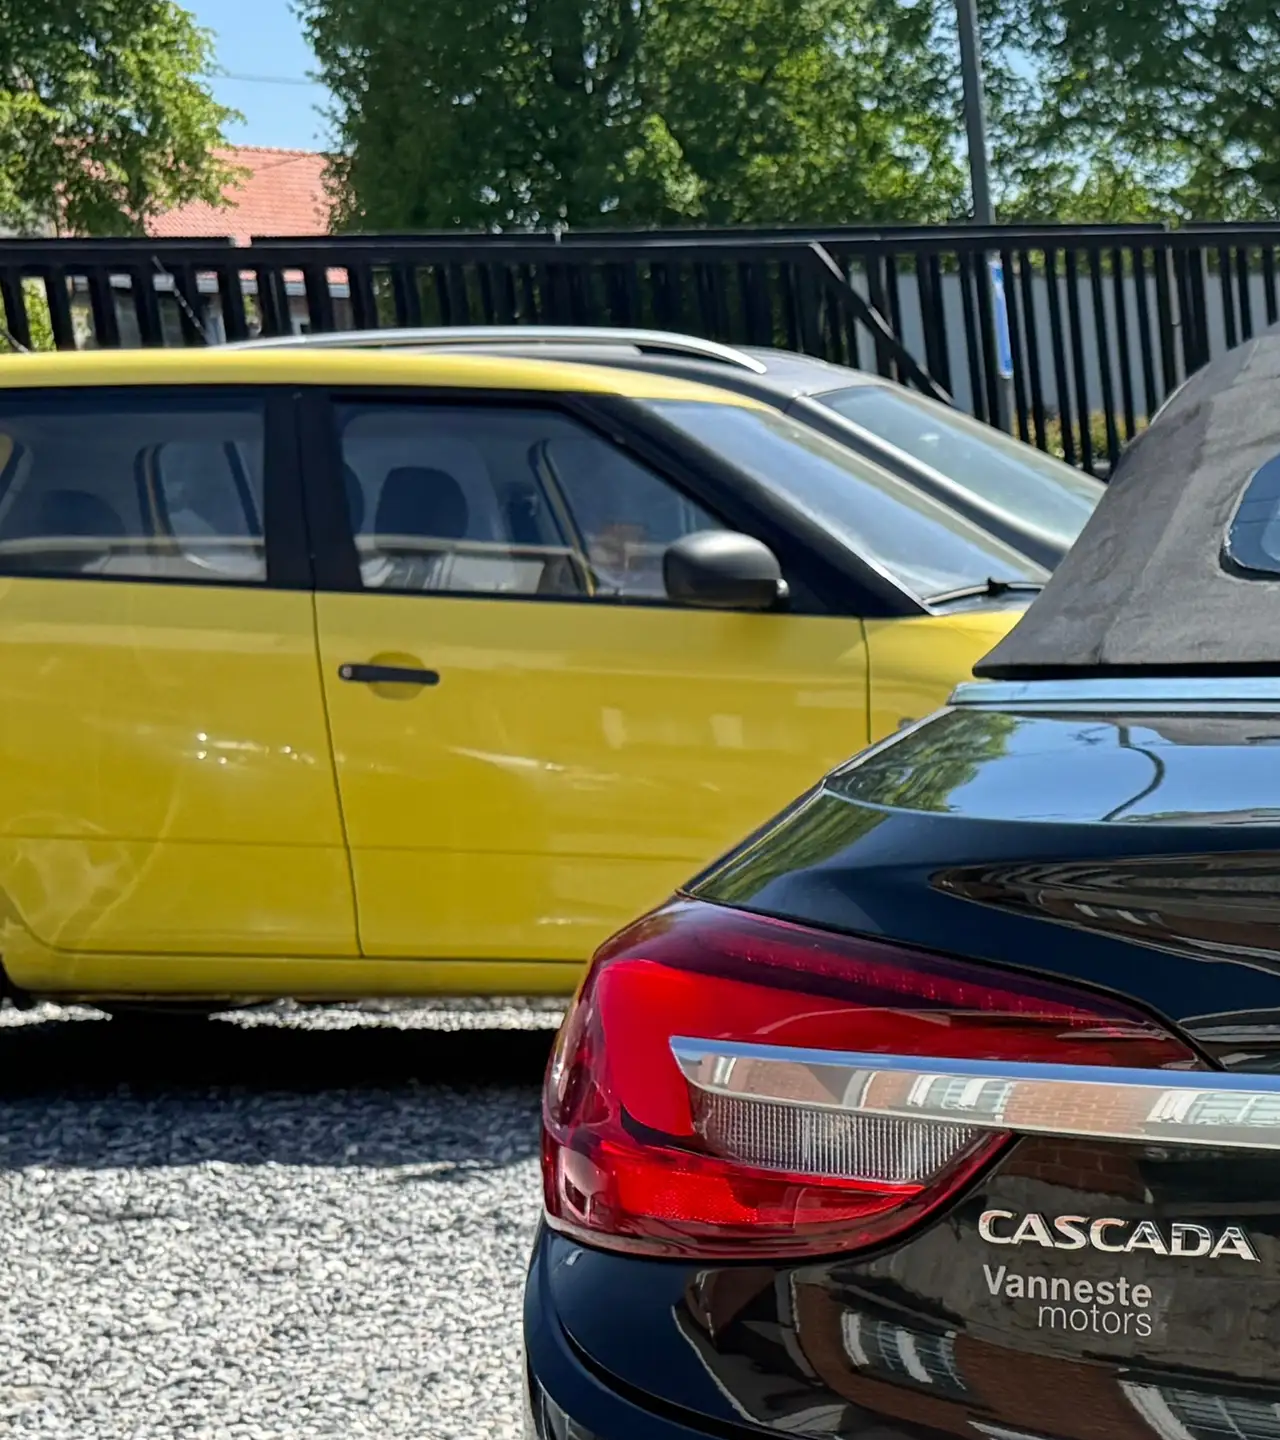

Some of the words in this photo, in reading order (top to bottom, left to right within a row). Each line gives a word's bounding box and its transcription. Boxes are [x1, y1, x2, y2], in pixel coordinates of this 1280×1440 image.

[977, 1209, 1260, 1262] CASCADA
[982, 1264, 1154, 1308] Vanneste
[1038, 1303, 1153, 1337] motors
